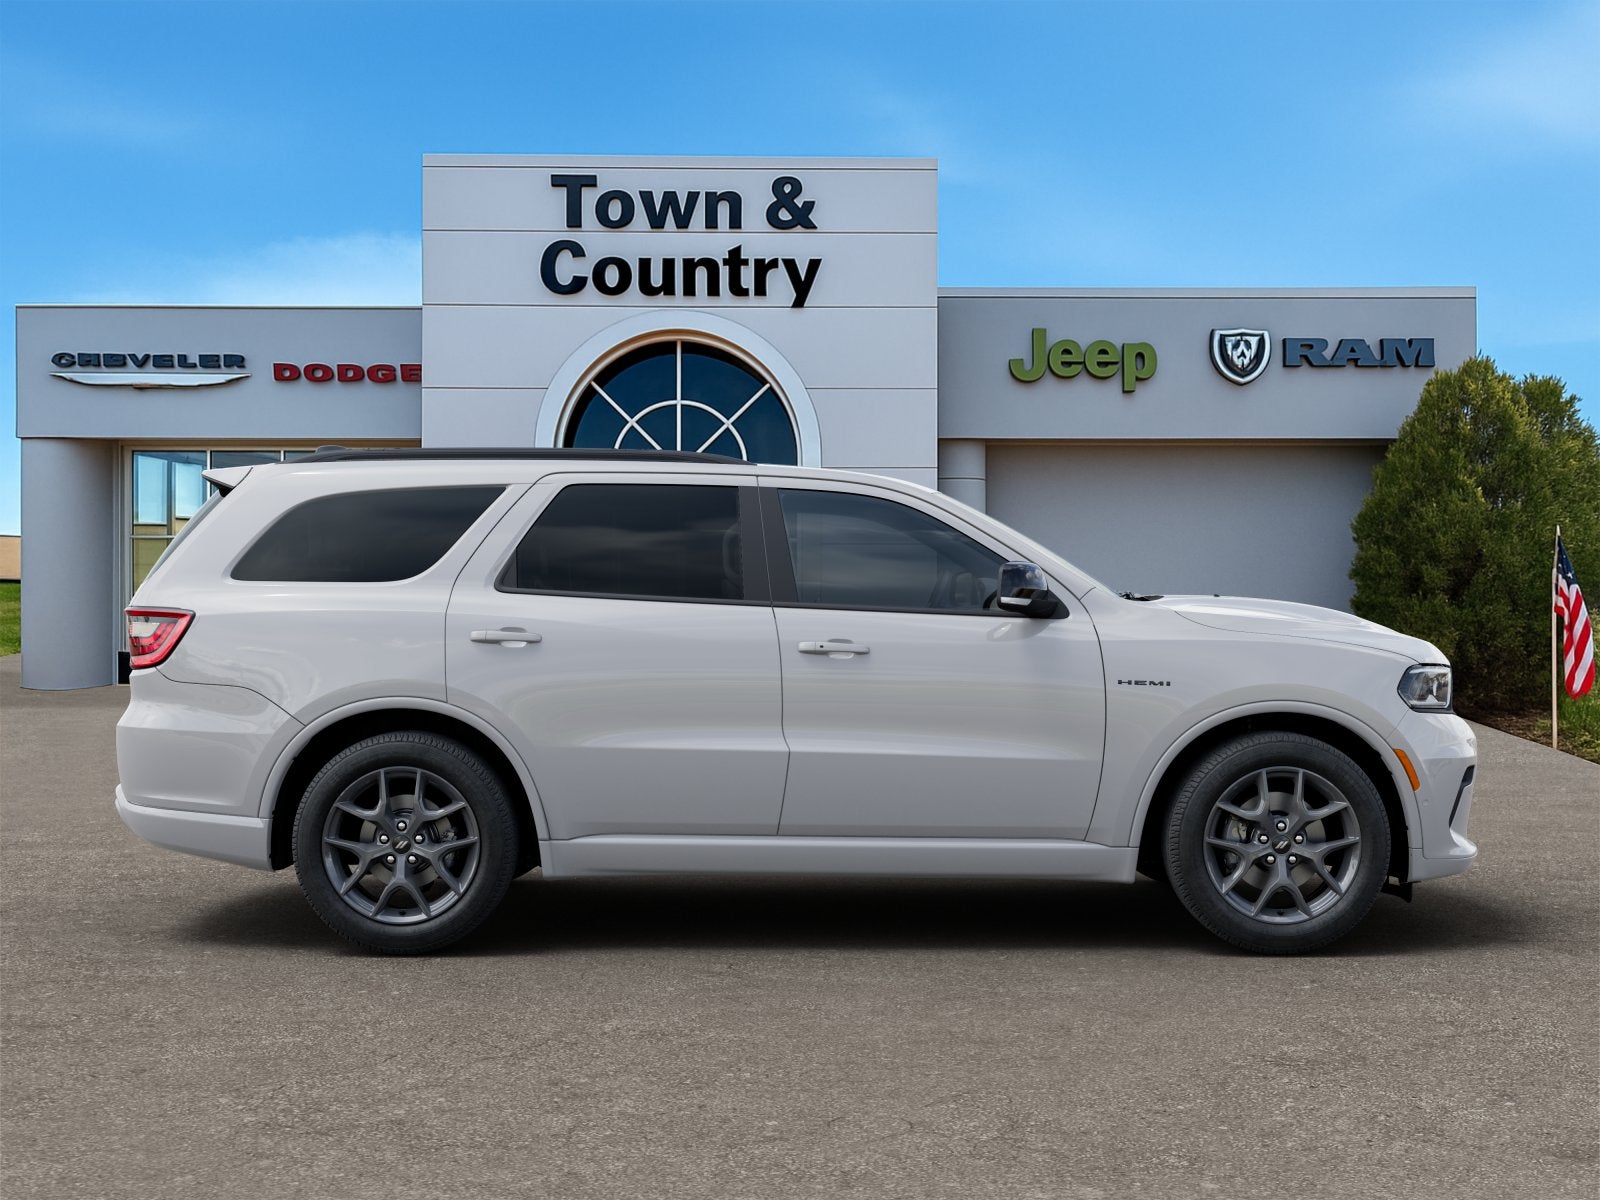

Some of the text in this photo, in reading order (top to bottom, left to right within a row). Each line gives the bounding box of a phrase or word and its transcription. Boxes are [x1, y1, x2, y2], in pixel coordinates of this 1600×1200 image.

[551, 175, 817, 229] Town &
[540, 239, 822, 308] Country
[274, 363, 422, 383] DODGE
[1009, 328, 1158, 393] Jeep
[1283, 337, 1436, 368] RAM
[1117, 679, 1171, 687] HEMI
